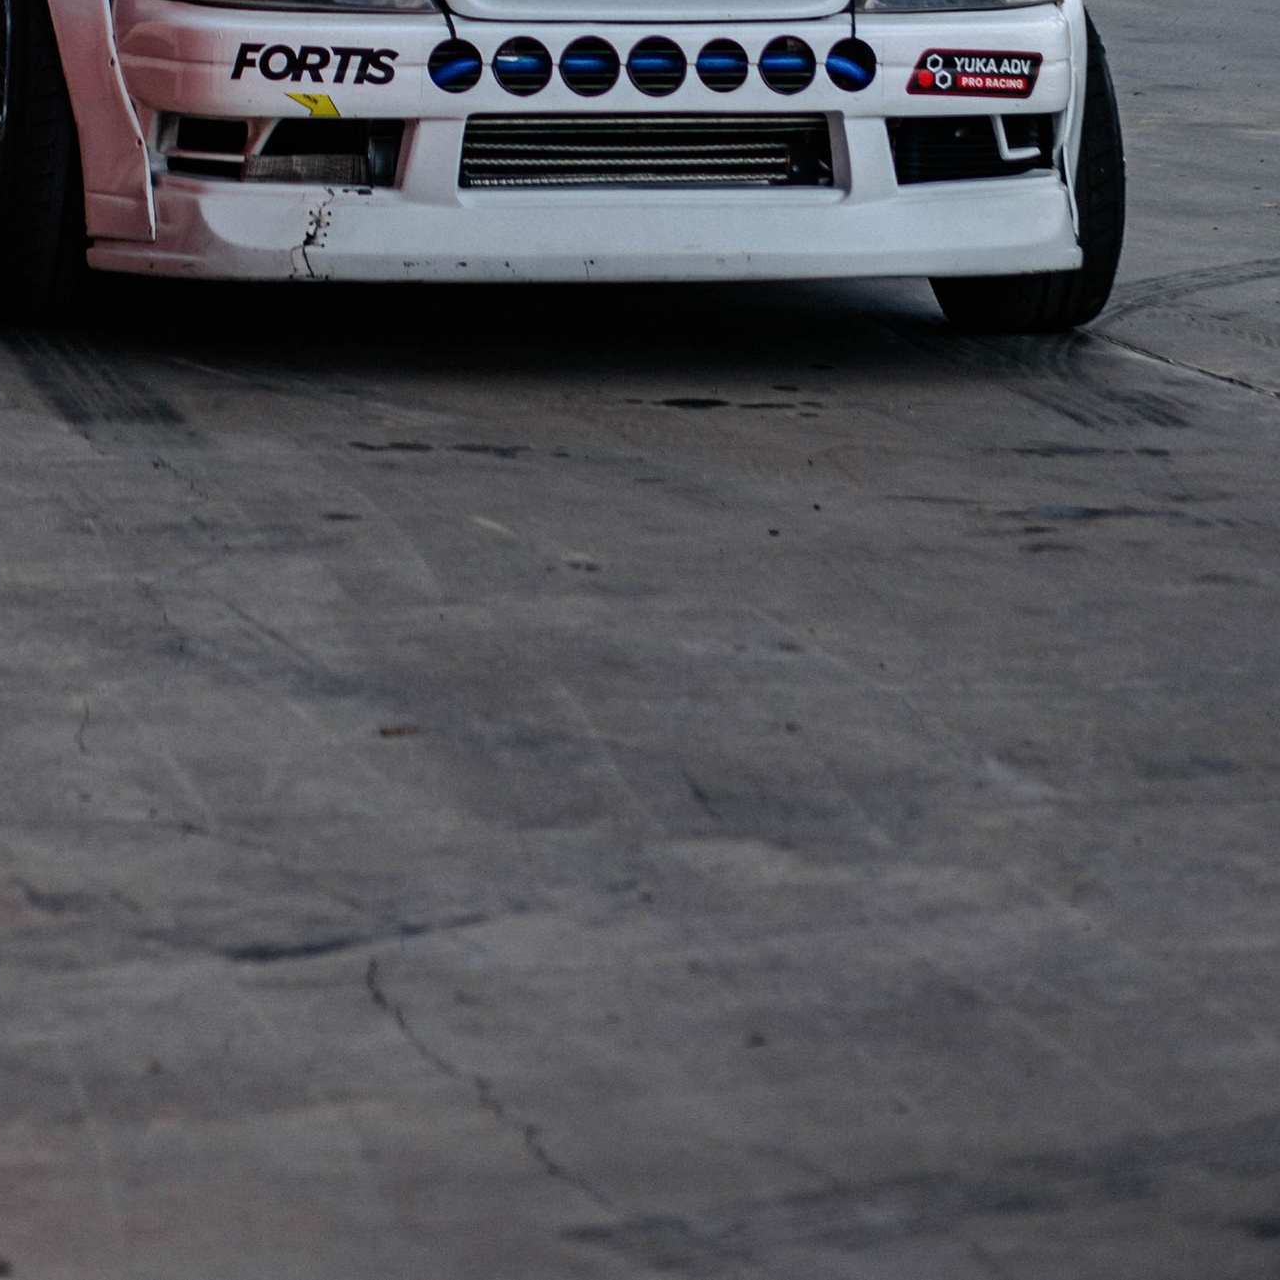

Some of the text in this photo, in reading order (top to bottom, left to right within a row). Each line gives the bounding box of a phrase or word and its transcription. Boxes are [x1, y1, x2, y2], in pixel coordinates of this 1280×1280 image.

[230, 42, 400, 85] FORTIS
[953, 56, 1032, 75] YUKA ADV
[961, 76, 1024, 90] PRO RACING
